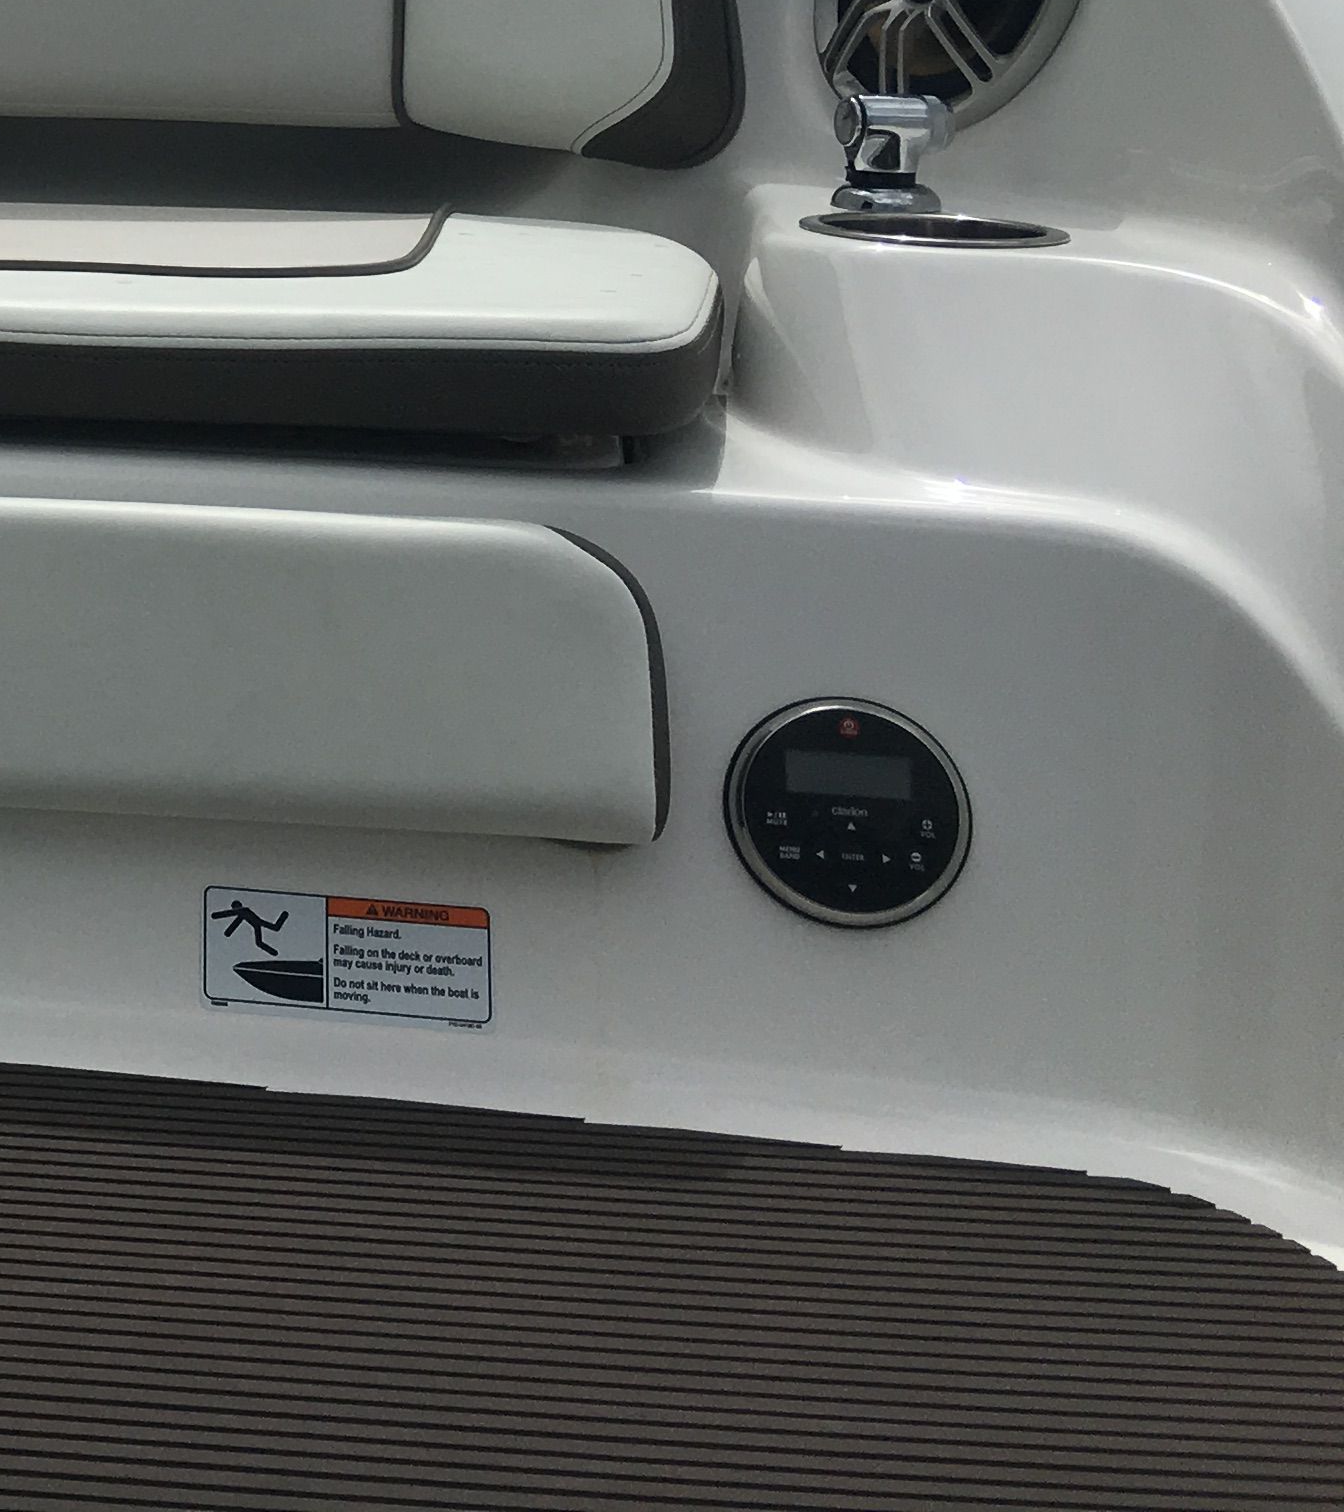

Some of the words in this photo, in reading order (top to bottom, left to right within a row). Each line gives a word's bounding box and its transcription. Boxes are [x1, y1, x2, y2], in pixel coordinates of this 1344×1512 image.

[383, 905, 449, 921] WARNING
[333, 924, 364, 938] Falling
[367, 927, 402, 938] Hazard.
[333, 944, 364, 959] Falling
[367, 948, 379, 957] on
[381, 948, 396, 959] the
[398, 950, 420, 961] deck
[423, 953, 433, 962] or
[435, 955, 483, 967] overboard
[333, 958, 352, 969] may
[355, 961, 382, 970] cause
[385, 961, 411, 975] injury
[414, 965, 424, 974] or
[426, 964, 455, 976] death.
[334, 977, 347, 988] Do
[349, 980, 364, 989] not
[367, 980, 378, 990] sit
[380, 981, 401, 993] here
[403, 984, 428, 995] when
[431, 985, 445, 997] the
[448, 986, 469, 998] boat
[471, 989, 479, 999] is
[334, 991, 371, 1004] moving.
